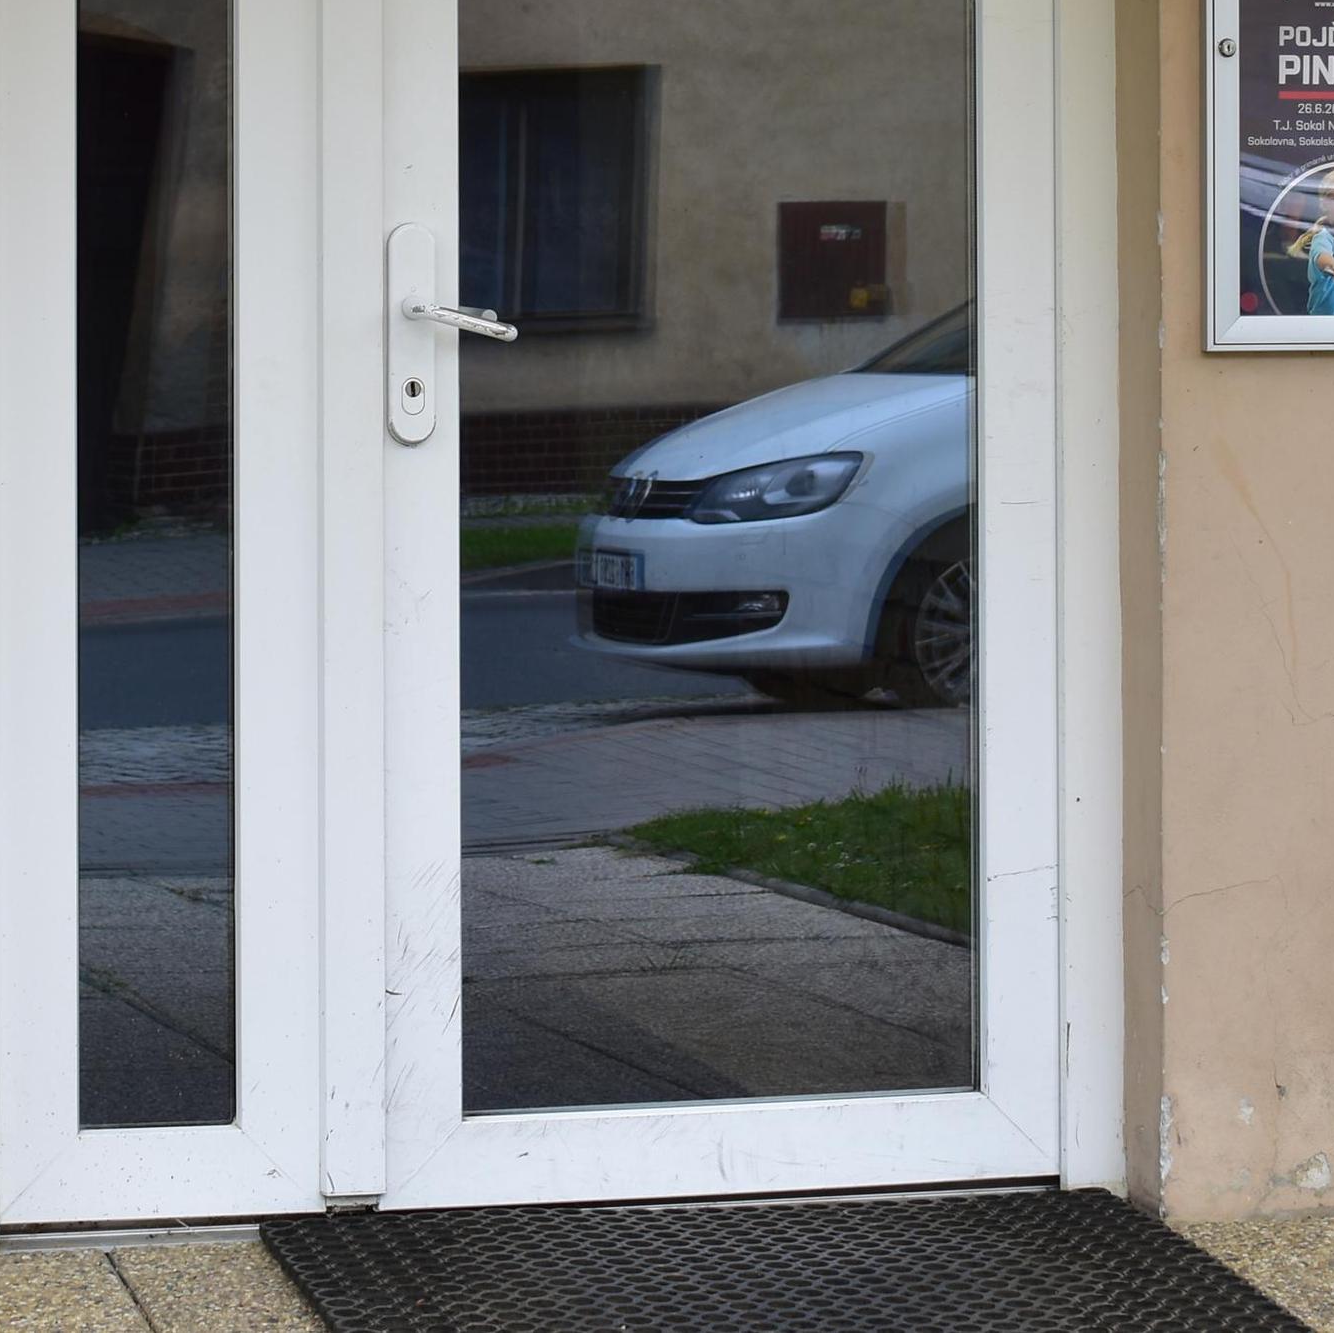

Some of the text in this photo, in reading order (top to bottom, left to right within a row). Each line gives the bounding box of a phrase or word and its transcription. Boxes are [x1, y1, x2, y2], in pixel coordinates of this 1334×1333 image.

[1273, 120, 1292, 131] T.J.
[1296, 120, 1325, 131] Sokol
[1247, 136, 1297, 147] Sokolovna,
